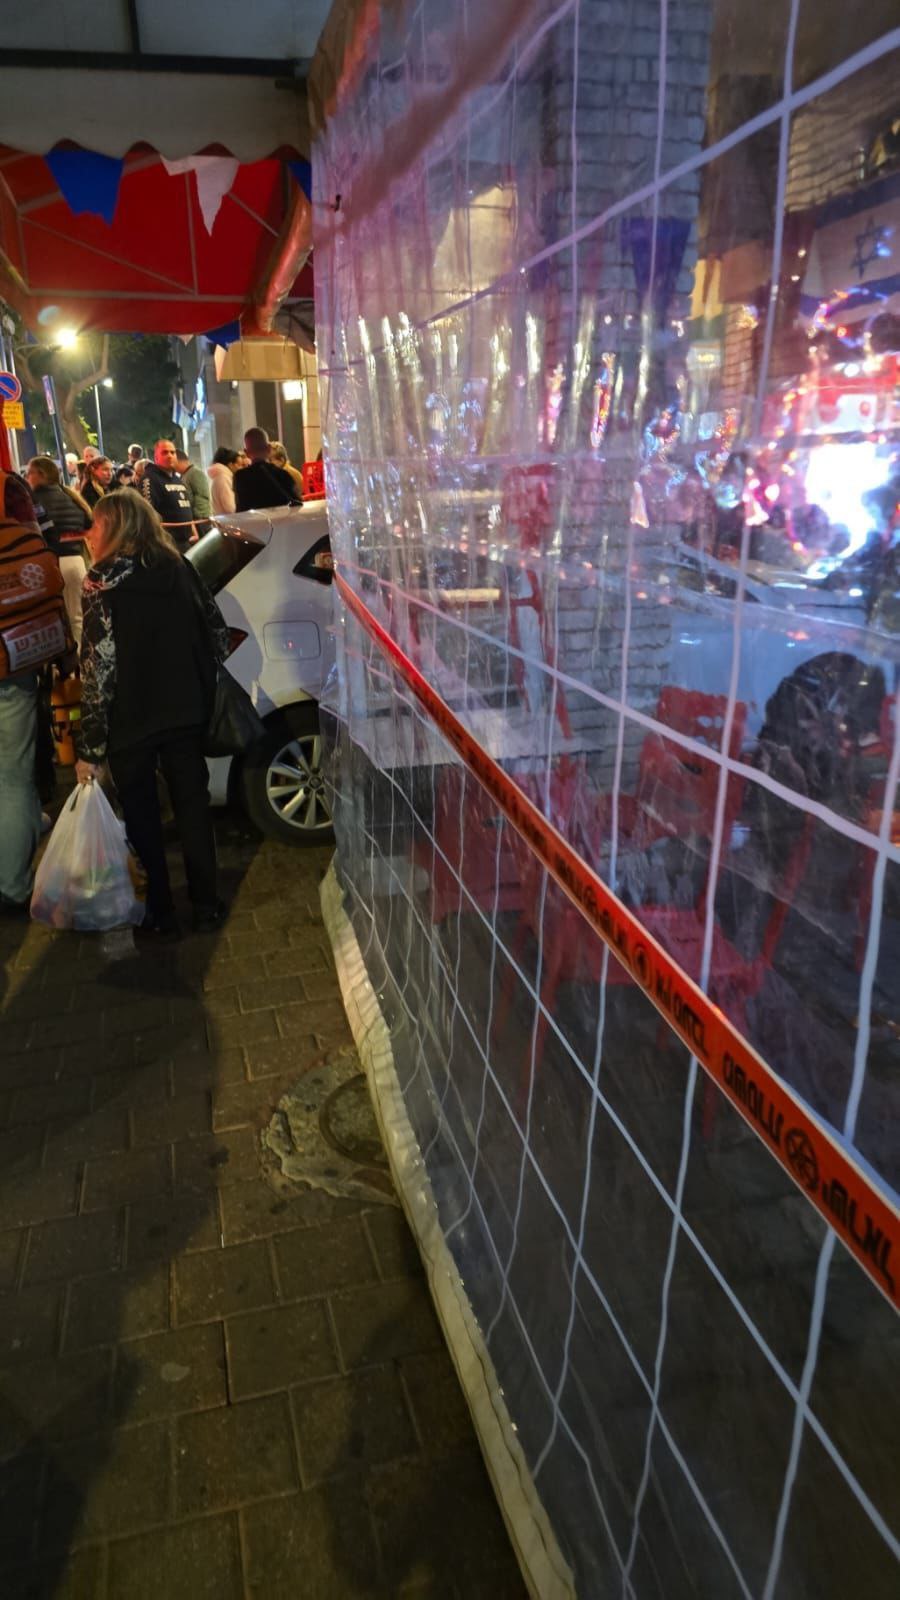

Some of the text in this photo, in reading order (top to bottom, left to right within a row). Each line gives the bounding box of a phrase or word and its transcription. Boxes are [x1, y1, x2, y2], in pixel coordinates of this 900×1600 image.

[15, 625, 58, 653] חובש
[722, 1051, 784, 1148] משטרת
[822, 1176, 896, 1297] ישראל
